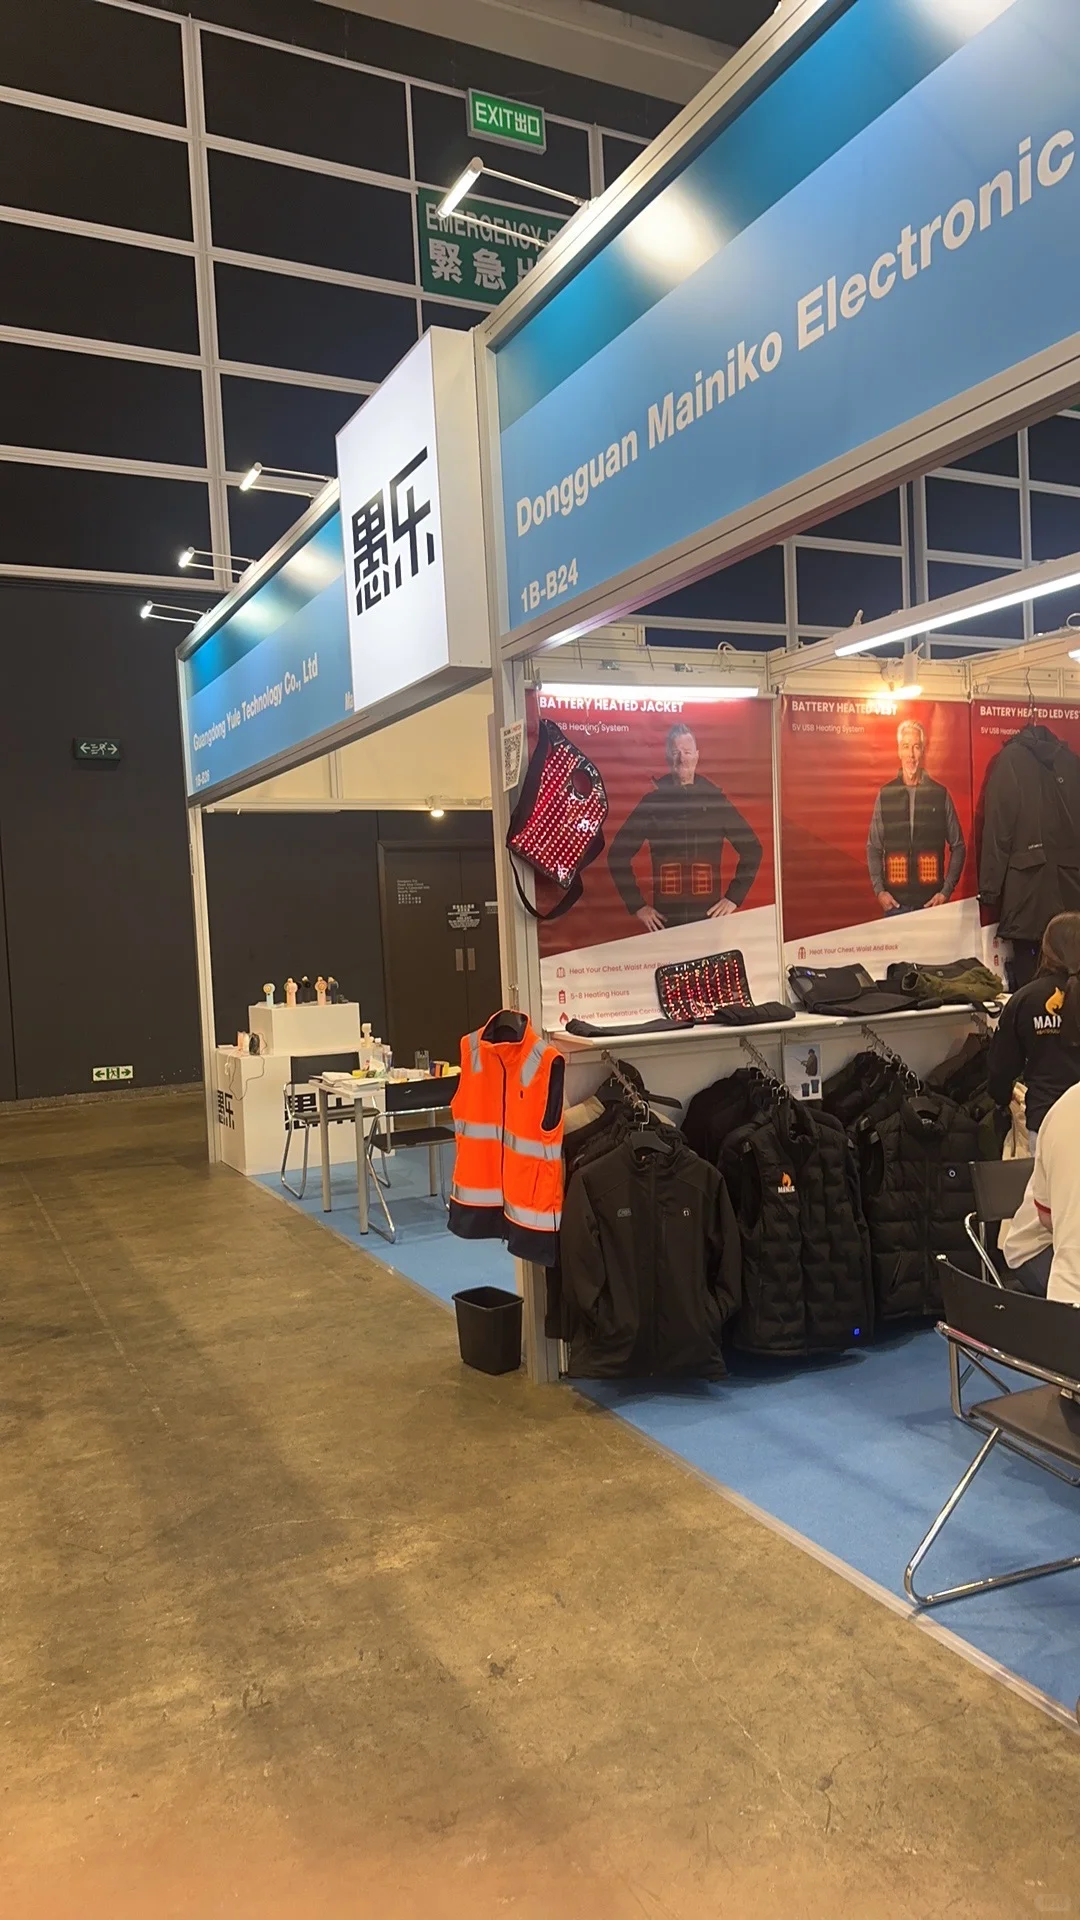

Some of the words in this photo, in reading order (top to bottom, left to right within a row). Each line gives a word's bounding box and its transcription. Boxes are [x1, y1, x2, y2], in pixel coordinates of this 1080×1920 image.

[425, 202, 542, 251] EMERGENCY
[517, 430, 638, 537] Dongguan
[648, 331, 782, 450] Mainiko
[797, 129, 1075, 350] Electronic
[521, 558, 578, 612] 1B-B24
[193, 719, 226, 751] Guangdong
[226, 706, 241, 731] Yule
[242, 681, 282, 721] Technology
[284, 672, 302, 695] Co.,
[303, 652, 318, 684] Ltd
[540, 696, 592, 711] BATTERY
[594, 698, 638, 712] HEATED
[640, 701, 684, 713] JACKET
[792, 701, 835, 713] BATTERY
[837, 703, 872, 715] HEATED
[980, 706, 1016, 718] BATTERY
[1049, 709, 1063, 719] LED
[601, 723, 629, 734] System
[816, 725, 840, 735] Heating
[841, 725, 865, 735] System
[569, 966, 586, 975] Heat
[586, 965, 601, 974] Your
[624, 962, 642, 971] Waist
[643, 961, 656, 970] And
[584, 990, 610, 1000] Heating
[611, 989, 630, 997] Hours
[596, 1008, 638, 1019] Temperature
